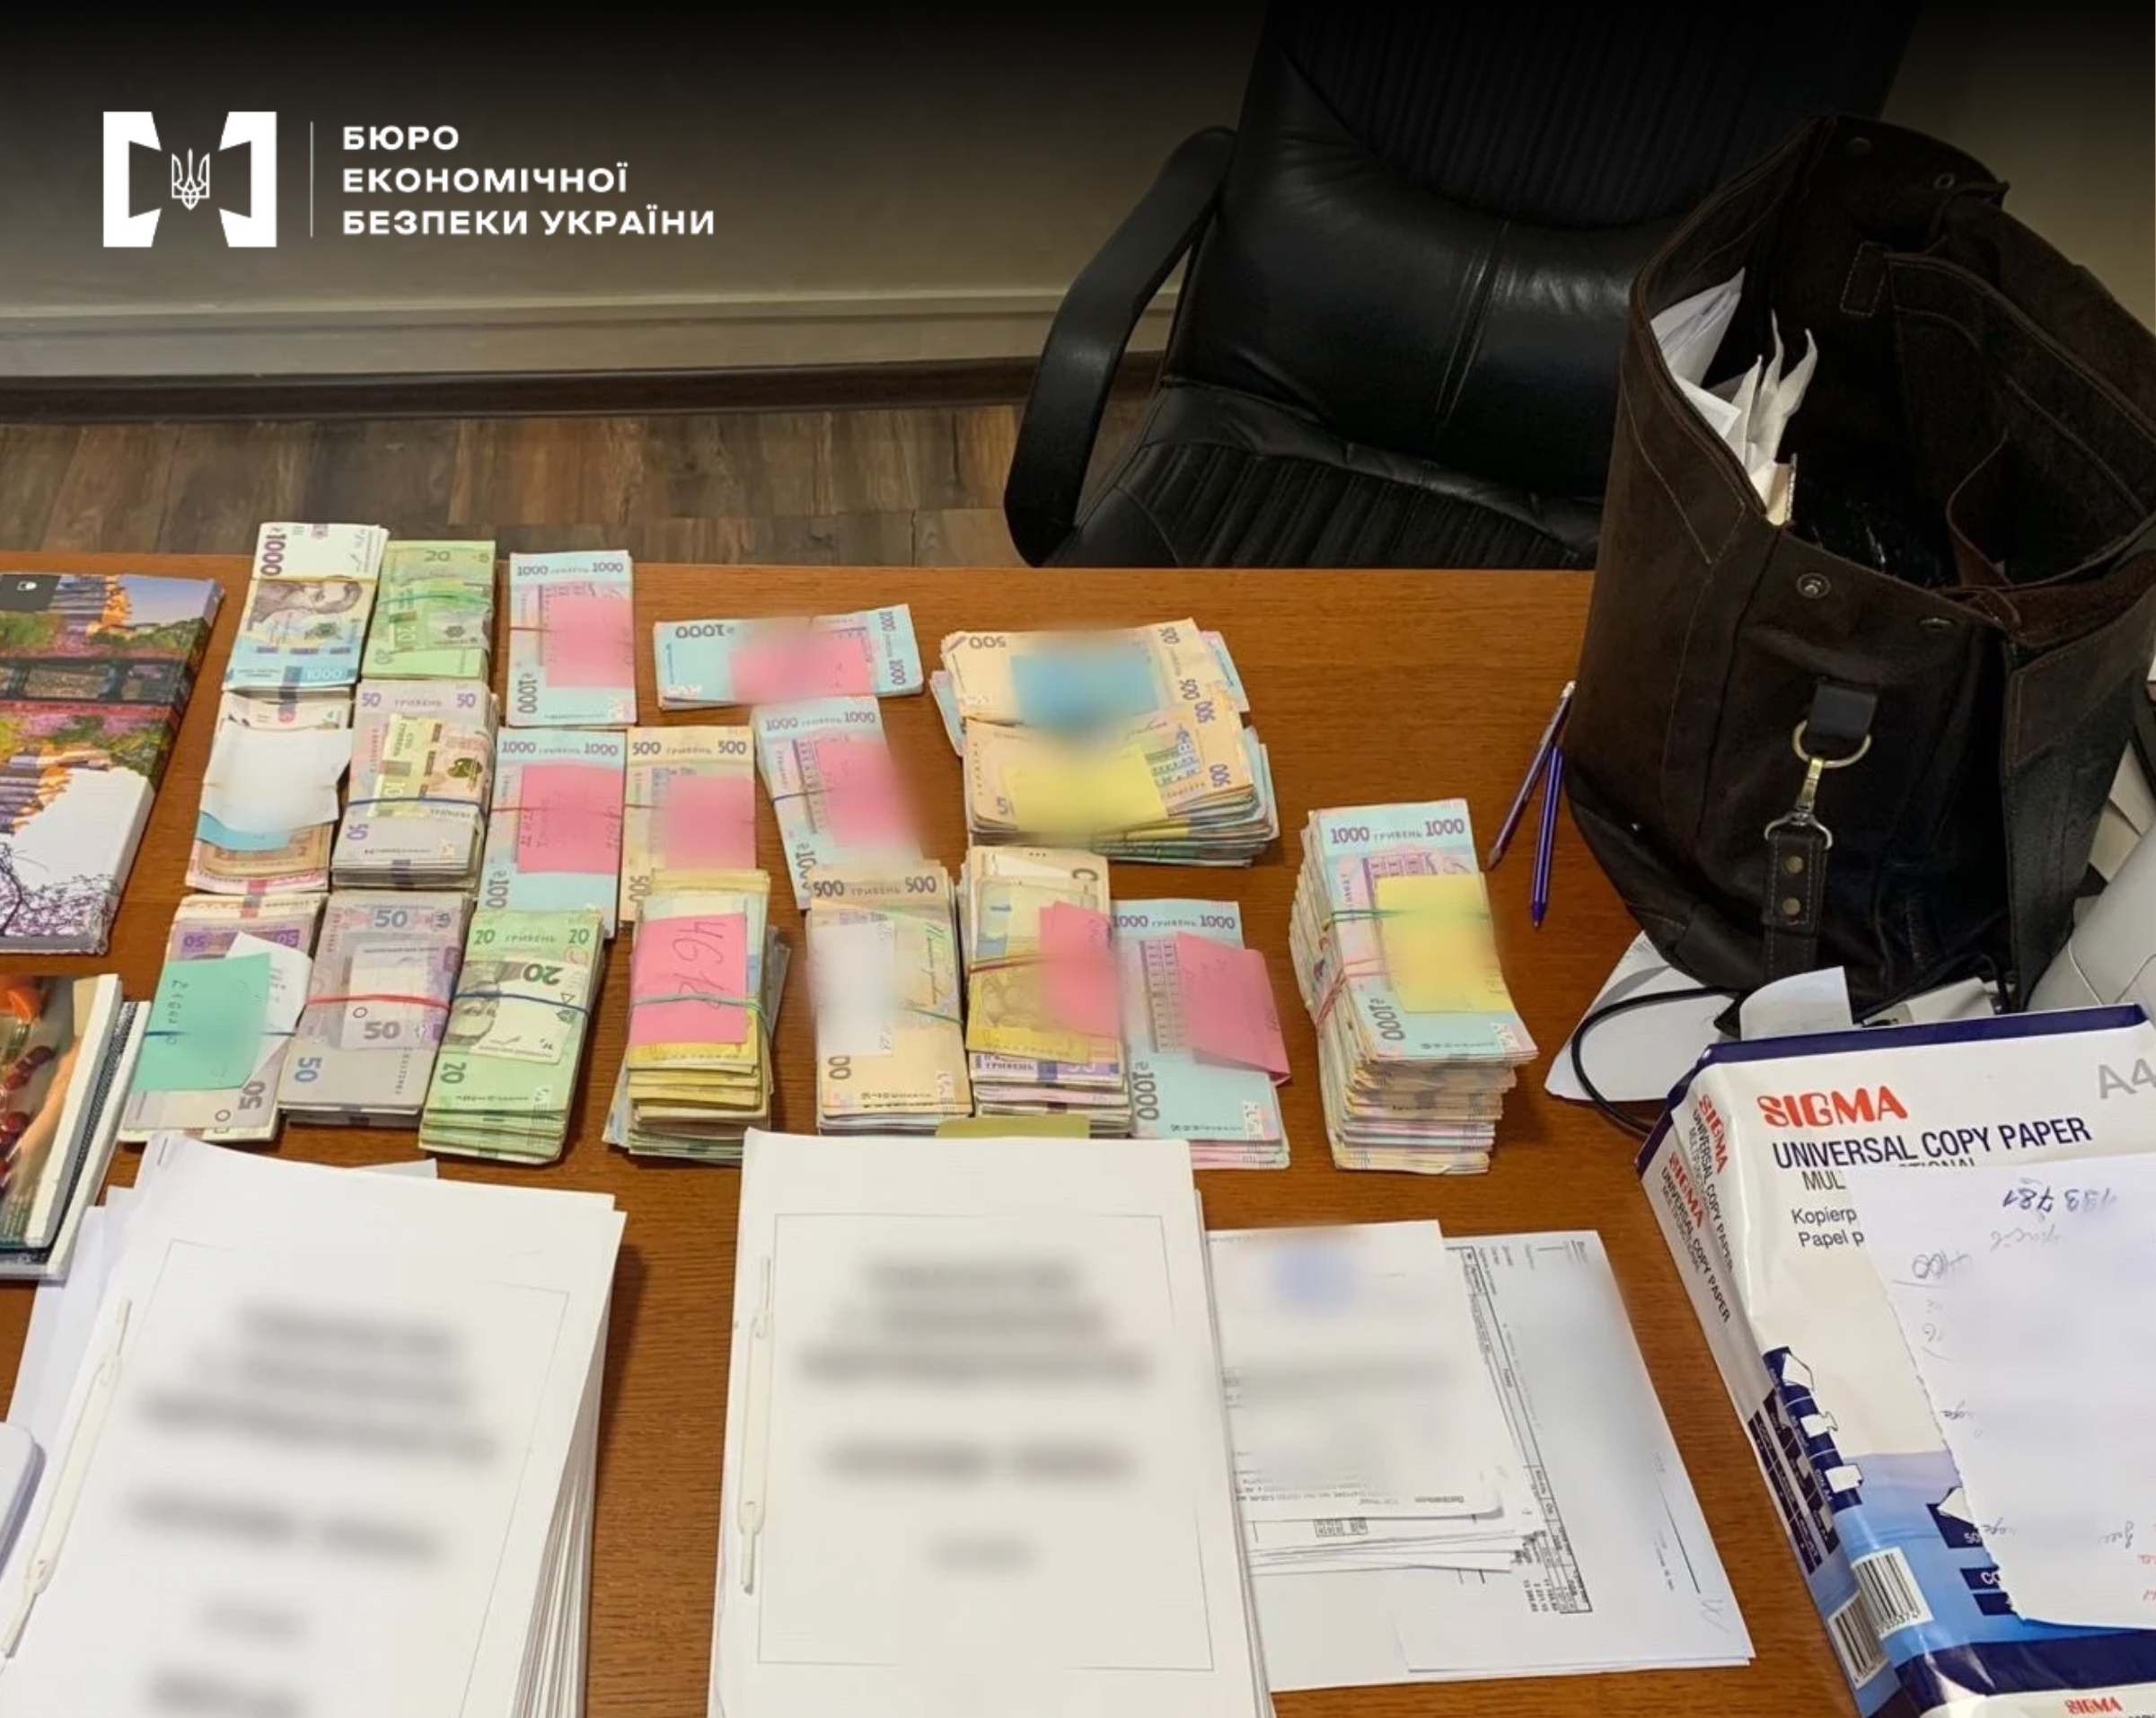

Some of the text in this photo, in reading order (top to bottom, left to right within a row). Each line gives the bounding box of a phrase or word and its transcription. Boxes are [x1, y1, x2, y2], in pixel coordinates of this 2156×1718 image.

[517, 565, 549, 576] 1000
[593, 562, 623, 572] 1000
[969, 636, 1007, 649] 500
[362, 692, 381, 707] 50
[457, 692, 476, 708] 50
[766, 718, 798, 731] 1000
[844, 711, 876, 724] 1000
[501, 741, 537, 754] 1000
[584, 743, 619, 756] 1000
[632, 742, 661, 754] 500
[717, 740, 746, 754] 500
[1331, 826, 1369, 844] 1000
[1425, 819, 1465, 835] 1000
[814, 880, 844, 897] 500
[906, 876, 937, 894] 500
[375, 909, 408, 929] 50
[1113, 914, 1148, 929] 1000
[1200, 914, 1235, 929] 1000
[474, 929, 495, 945] 20
[569, 928, 590, 945] 20
[523, 964, 563, 985] 20
[364, 1021, 400, 1040] 50
[294, 1056, 321, 1083] 50
[440, 1062, 466, 1084] 20
[828, 1055, 851, 1079] 00
[2099, 1058, 2156, 1098] A4
[238, 1080, 266, 1110] 50
[1757, 1086, 1908, 1128] SIGMA
[1699, 1094, 1729, 1174] SIGMA
[1773, 1116, 2093, 1168] UNIVERSAL COPY PAPER
[1693, 1109, 1713, 1179] UNIVERSAL
[1706, 1184, 1722, 1228] COPY
[1668, 1152, 1704, 1229] SIGMA
[1791, 1206, 1857, 1226] Kopierp
[1661, 1167, 1730, 1323] UNIVERSAL COPY PAPER
[1798, 1229, 1849, 1248] Papel
[2064, 1696, 2122, 1714] SIGMA
